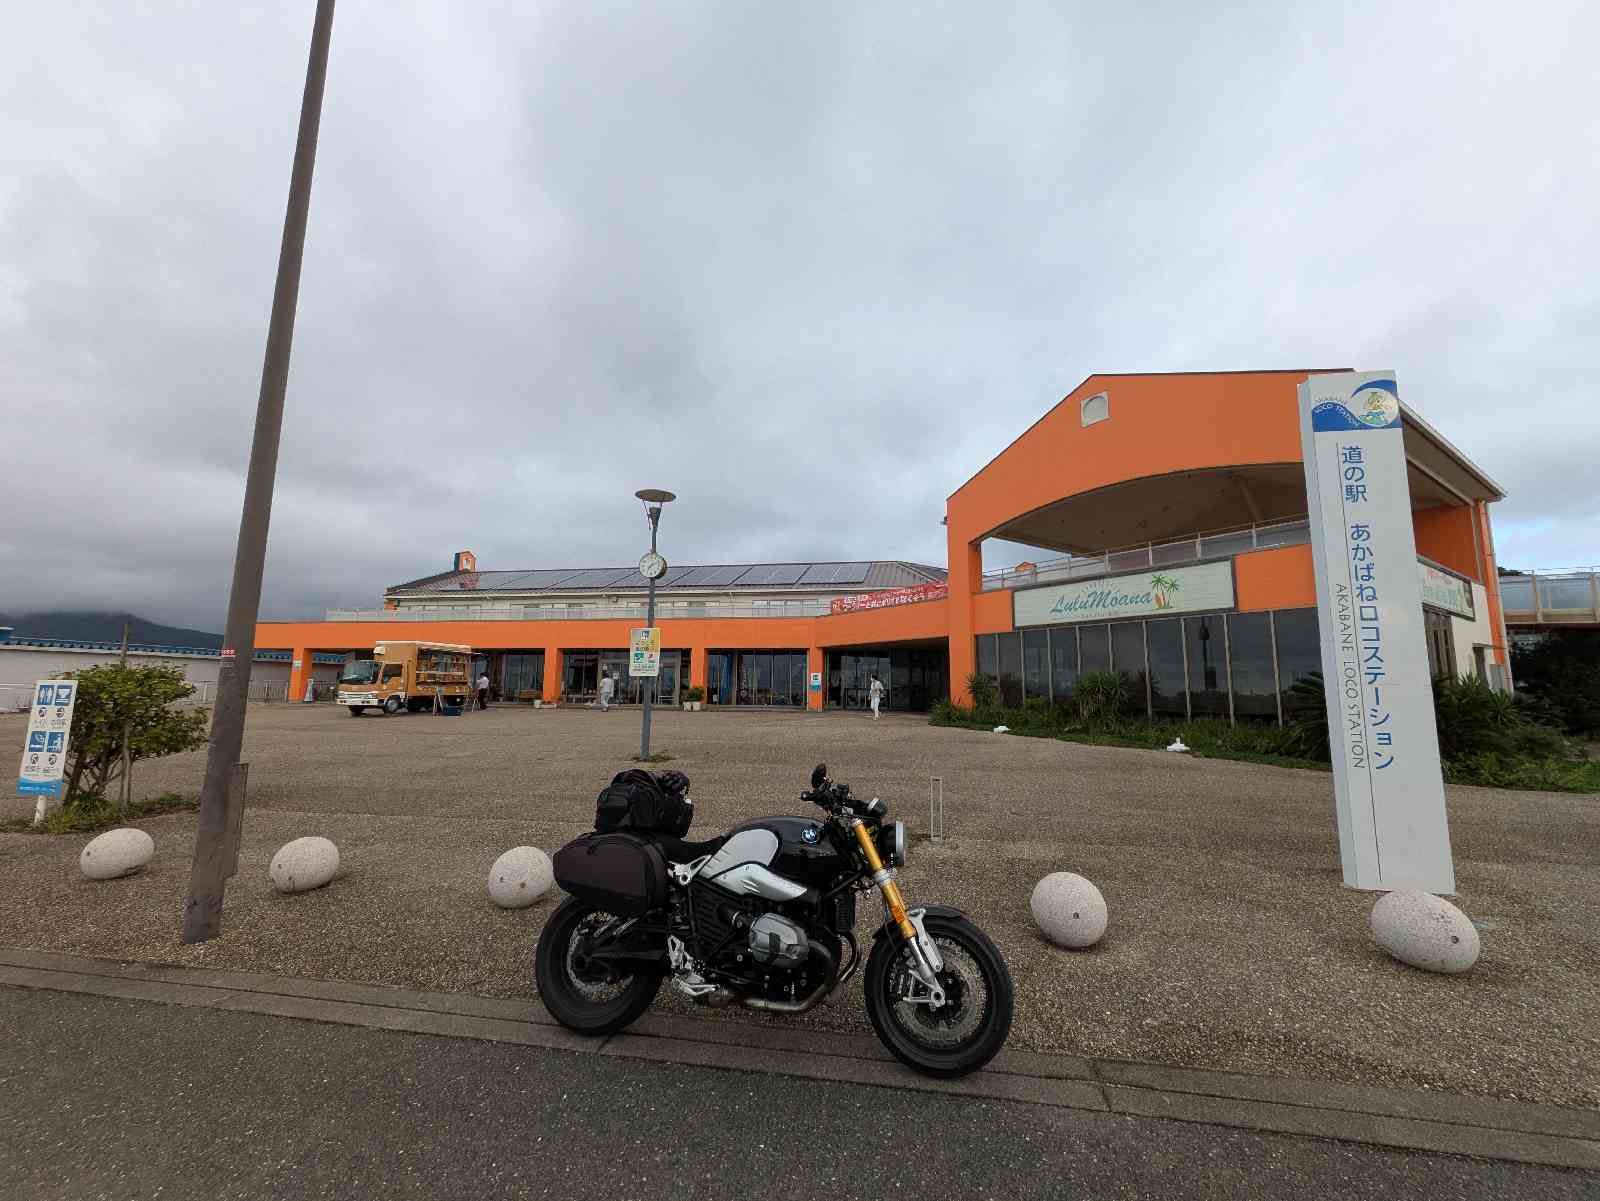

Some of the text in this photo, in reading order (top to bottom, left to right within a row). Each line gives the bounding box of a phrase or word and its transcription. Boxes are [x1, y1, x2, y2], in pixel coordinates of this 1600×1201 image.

[1342, 446, 1368, 502] 道の駅
[1336, 583, 1366, 768] AKABANE LOCO STATION
[1351, 523, 1394, 769] あかばねロコステーション
